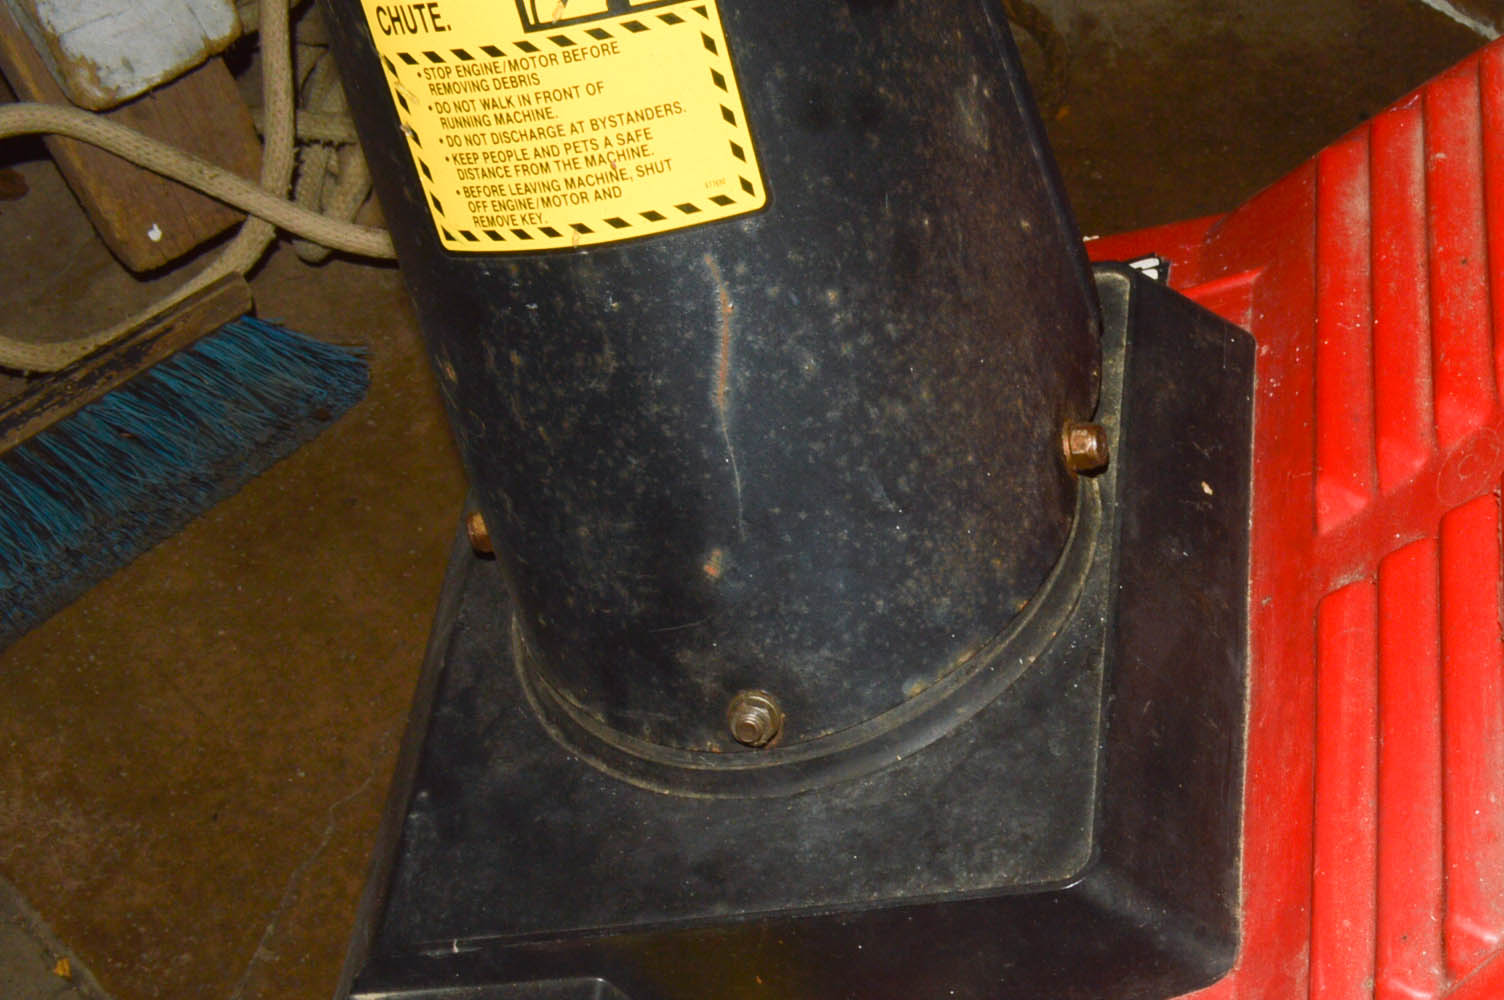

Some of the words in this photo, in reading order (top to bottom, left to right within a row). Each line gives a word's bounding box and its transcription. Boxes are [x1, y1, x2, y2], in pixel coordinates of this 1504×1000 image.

[376, 2, 453, 36] CHUTE.
[423, 66, 452, 80] STOP
[455, 53, 559, 78] ENGINE/MOTOR
[562, 41, 620, 64] BEFORE
[428, 79, 490, 96] REMOVING
[492, 72, 540, 91] DEBRIS
[434, 101, 451, 114] DO
[453, 99, 476, 113] NOT
[479, 95, 515, 111] WALK
[517, 94, 532, 106] IN
[534, 85, 580, 104] FRONT
[585, 81, 604, 96] OF
[439, 114, 492, 129] RUNNING
[493, 107, 557, 125] MACHINE.
[445, 134, 462, 148] DO
[464, 133, 487, 146] NOT
[490, 124, 566, 145] DISCHARGE
[570, 120, 584, 135] AT
[589, 101, 686, 131] BYSTANDERS.
[452, 152, 479, 165] KEEP
[482, 148, 530, 164] PEOPLE
[534, 144, 560, 159] AND
[563, 138, 599, 155] PETS
[604, 136, 613, 149] A
[616, 127, 653, 146] SAFE
[456, 165, 512, 181] DISTANCE
[514, 161, 551, 176] FROM
[553, 157, 582, 171] THE
[584, 144, 654, 168] MACHINE.
[462, 184, 507, 198] BEFORE
[508, 179, 561, 196] LEAVING
[564, 167, 632, 190] MACHINE,
[635, 158, 671, 178] SHUT
[468, 200, 488, 213] OFF
[490, 191, 589, 212] ENGINE/MOTOR
[594, 186, 622, 202] AND
[472, 214, 519, 228] REMOVE
